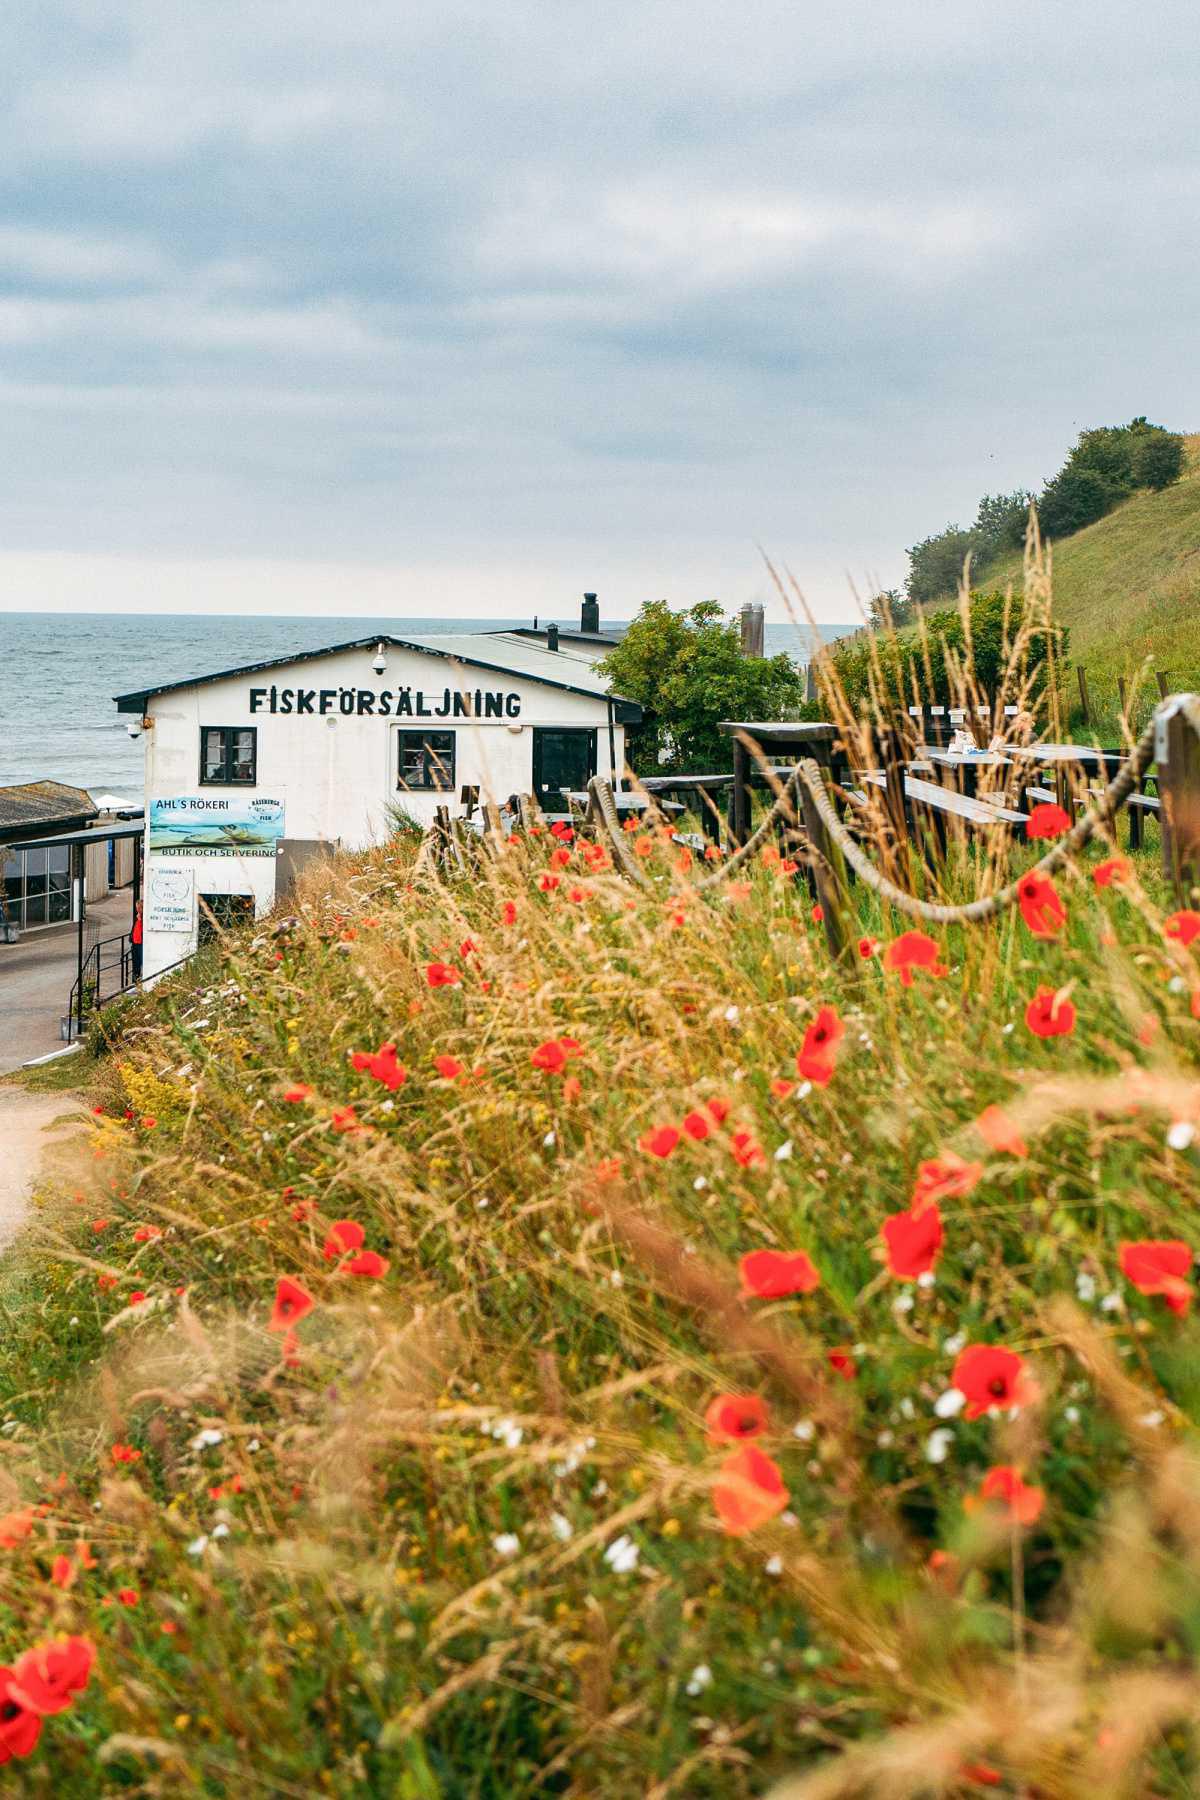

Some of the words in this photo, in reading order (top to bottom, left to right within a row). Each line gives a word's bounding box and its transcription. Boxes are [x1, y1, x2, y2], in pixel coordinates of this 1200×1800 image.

[249, 685, 521, 718] FISKFÖRSÄLJNING
[190, 798, 229, 810] RÖKERI
[162, 848, 192, 856] BUTIK
[195, 848, 217, 856] OCH
